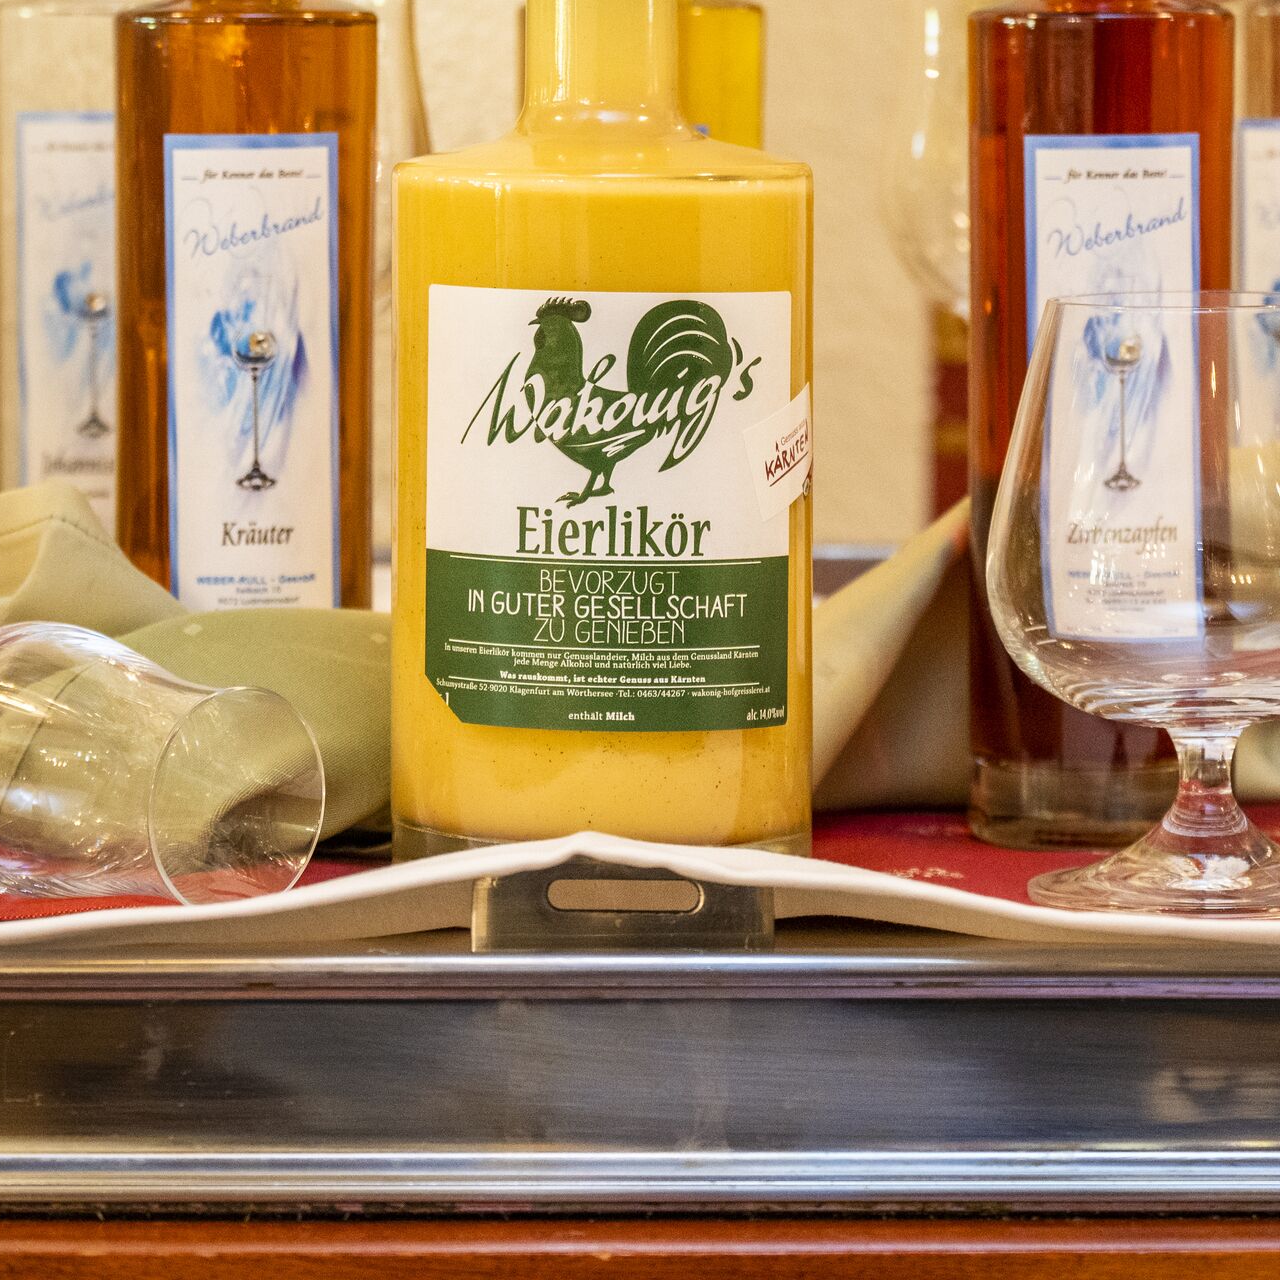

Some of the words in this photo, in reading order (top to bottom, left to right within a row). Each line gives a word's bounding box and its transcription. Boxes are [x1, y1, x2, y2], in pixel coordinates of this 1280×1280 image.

[184, 196, 322, 258] Weberbrand
[1047, 197, 1186, 258] Weberbrand
[461, 337, 762, 465] Wakonig's
[222, 522, 294, 547] Kräuter
[516, 506, 711, 557] Eierlikör
[540, 569, 680, 595] BEVORZUGT
[468, 589, 484, 613] IN
[491, 591, 565, 618] GUTER
[574, 594, 747, 619] GESELLSCHAFT
[534, 618, 565, 642] ZU
[445, 643, 451, 651] In
[452, 645, 477, 654] unseren
[479, 646, 509, 657] Eierlikör
[511, 649, 545, 659] kommen
[547, 652, 562, 660] nur
[632, 653, 654, 661] Milch
[672, 652, 689, 661] dem
[691, 651, 731, 660] Genussland
[734, 650, 759, 659] Kärnten
[513, 658, 530, 667] jede
[532, 658, 558, 668] Menge
[560, 660, 592, 669] Alkohol
[594, 661, 610, 669] und
[612, 661, 650, 669] natürlich
[652, 660, 667, 669] viel
[669, 660, 692, 669] Liebe.
[500, 670, 516, 680] Was
[518, 672, 571, 683] rauskommt,
[573, 674, 585, 683] ist
[587, 674, 617, 684] echter
[620, 676, 652, 684] Genuss
[671, 675, 706, 684] Kärnten
[509, 685, 550, 696] Klagenfurt
[567, 687, 614, 698] Wörthersee
[637, 689, 686, 699] 0463/44267
[568, 711, 603, 720] enthält
[606, 711, 635, 720] Milch
[747, 710, 759, 720] alc.
